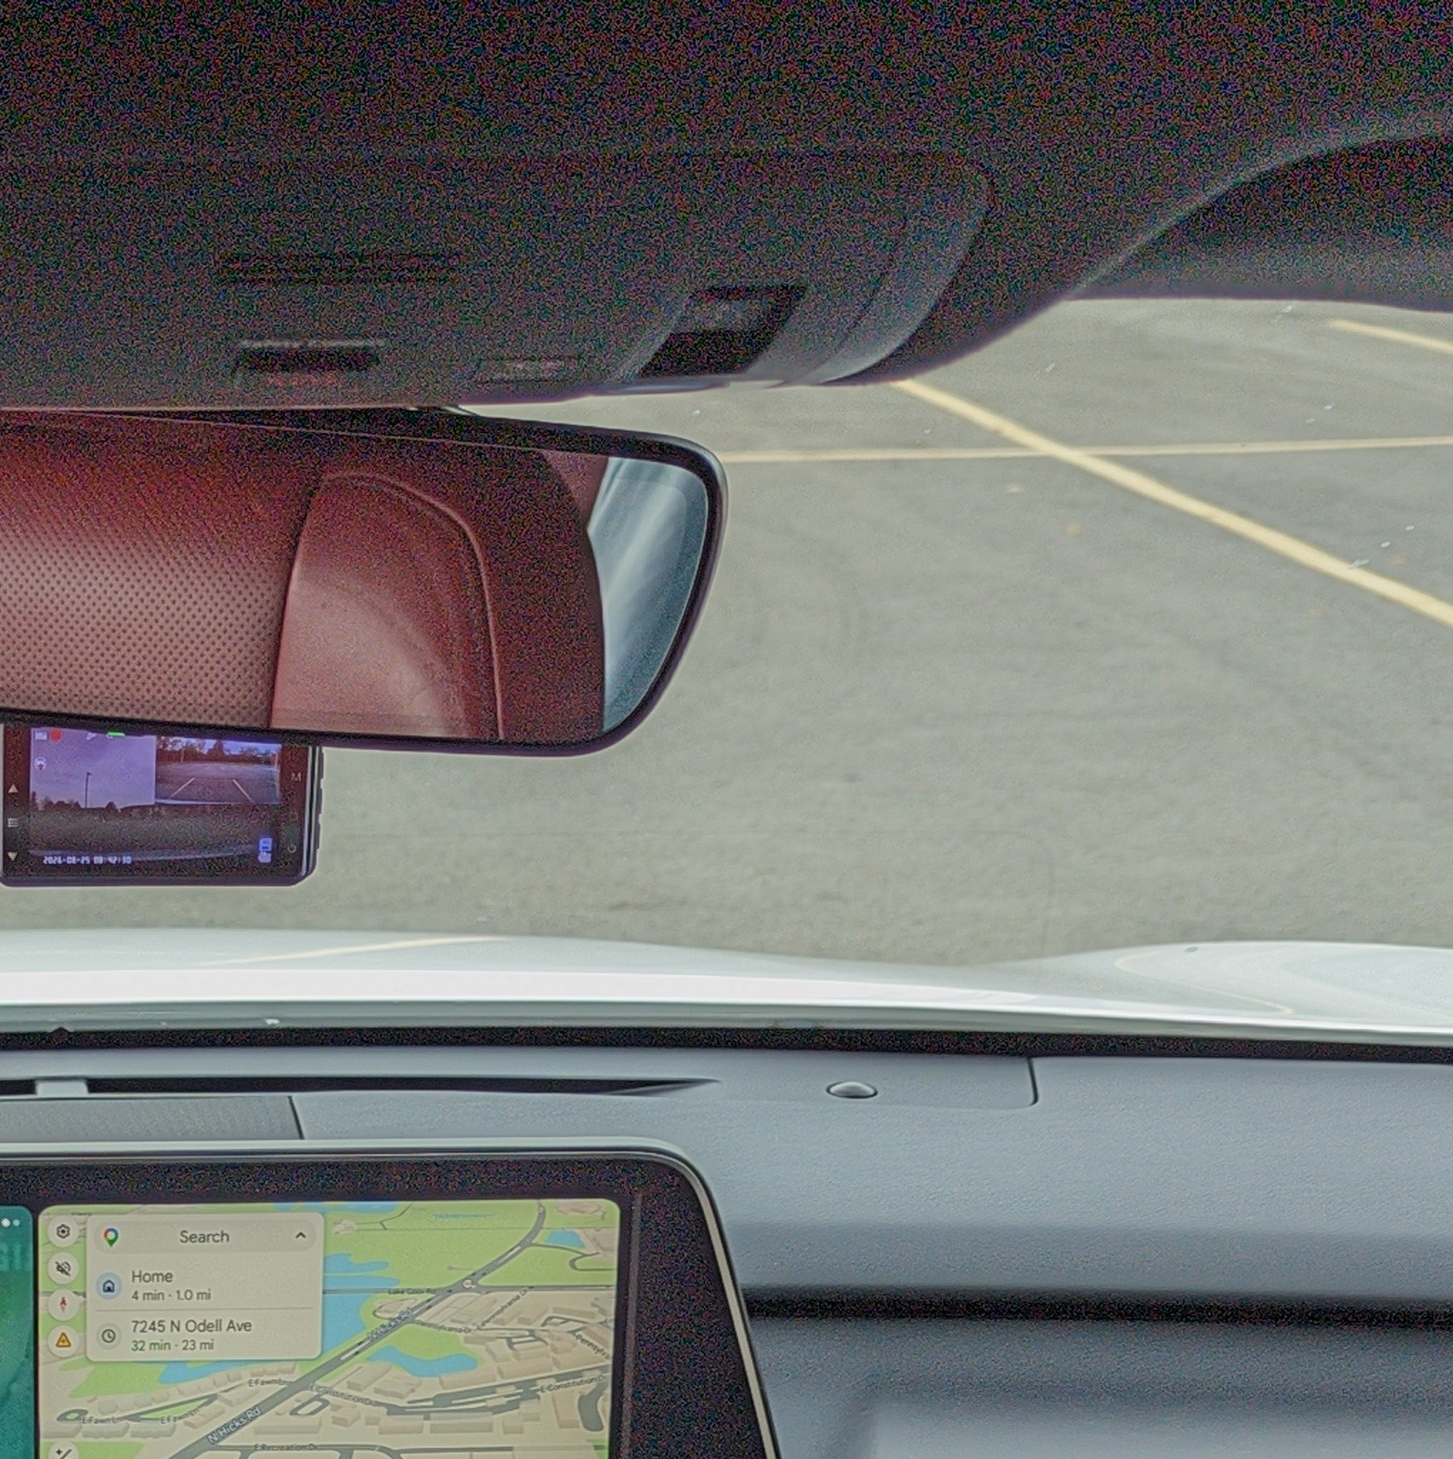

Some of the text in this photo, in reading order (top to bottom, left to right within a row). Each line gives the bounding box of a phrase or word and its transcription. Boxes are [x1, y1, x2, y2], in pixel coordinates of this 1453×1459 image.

[179, 1230, 230, 1244] Search
[131, 1270, 174, 1283] Home
[131, 1289, 211, 1300] 4 min 1.0 mi
[131, 1318, 252, 1333] 7245 N Odell Ave
[131, 1338, 214, 1352] 32 min 23 mi
[207, 1405, 262, 1445] N Hicks Rd
